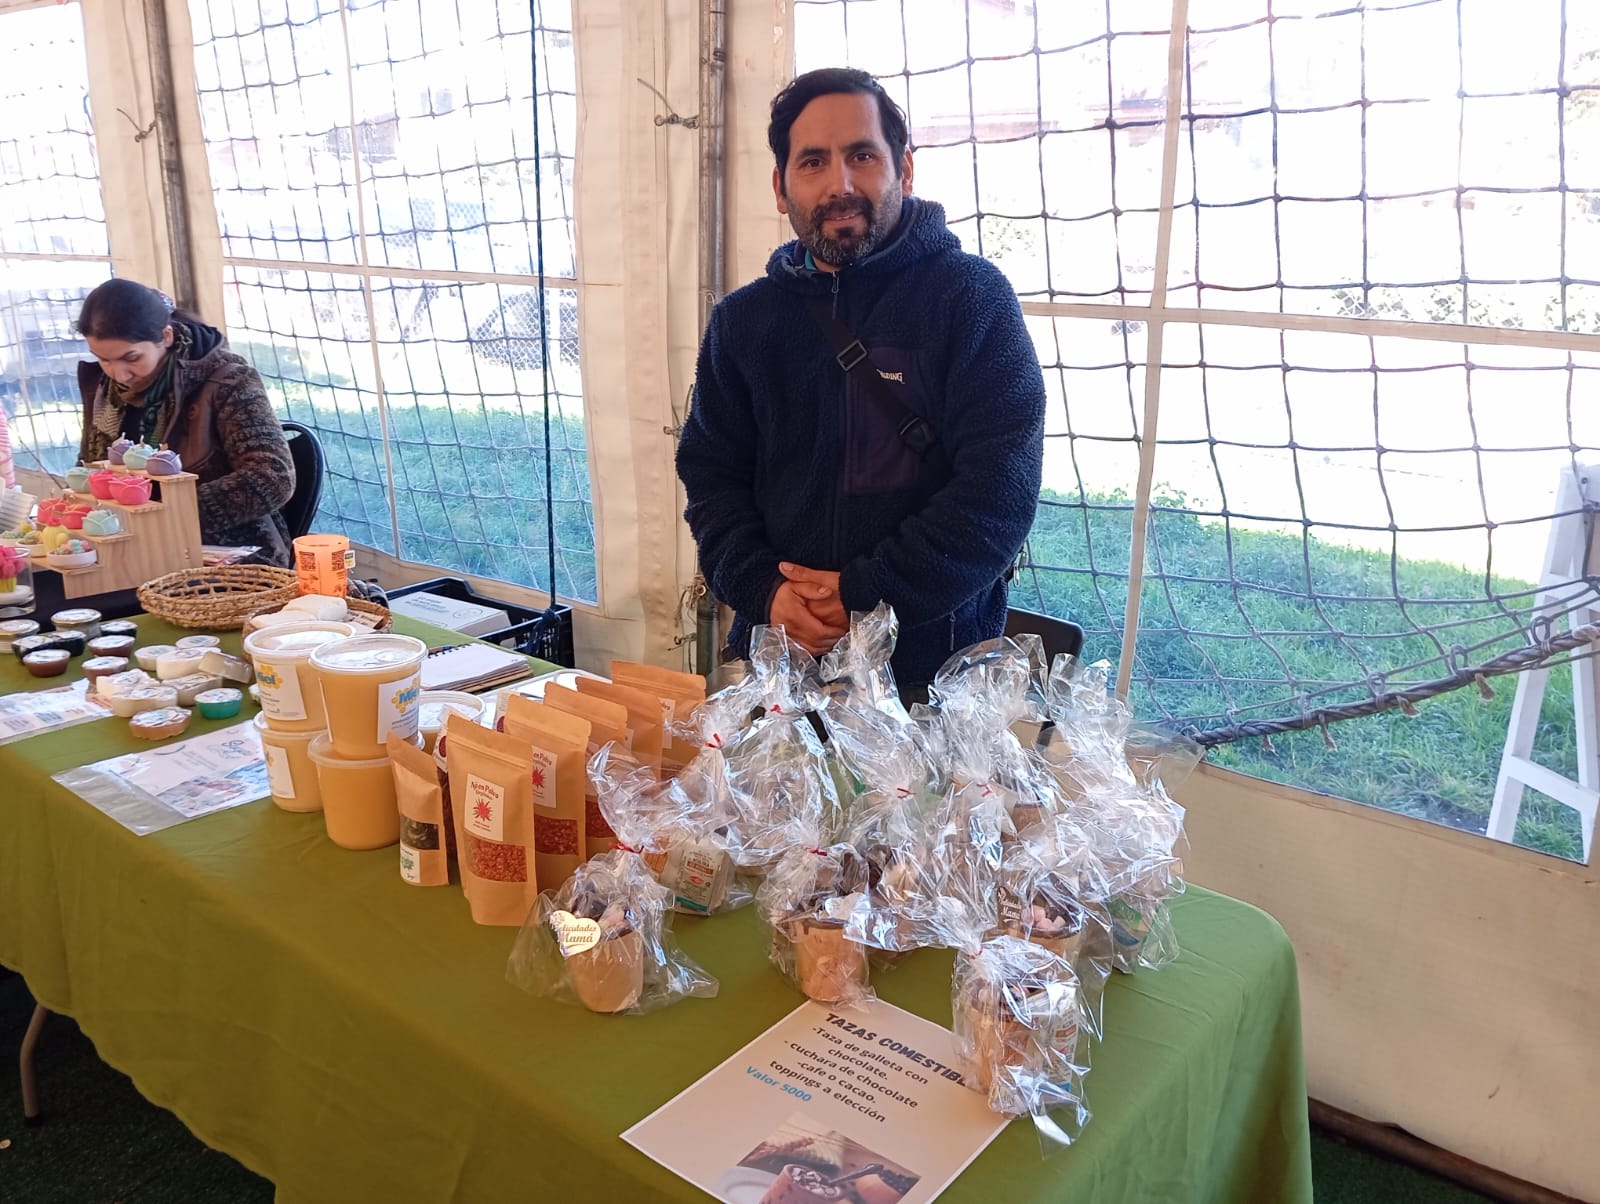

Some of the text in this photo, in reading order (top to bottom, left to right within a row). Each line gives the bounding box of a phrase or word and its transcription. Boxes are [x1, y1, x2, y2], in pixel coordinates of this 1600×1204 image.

[825, 1013, 966, 1086] TAZAS COMESTIBL
[828, 1048, 888, 1080] chocolate.
[844, 1042, 860, 1052] de
[859, 1047, 903, 1072] galleta
[904, 1069, 929, 1085] con
[746, 1065, 812, 1102] Valor 5000
[769, 1060, 886, 1122] toppings a elección
[789, 1041, 837, 1068] cuchara
[839, 1064, 855, 1076] de
[856, 1073, 918, 1108] chocolate
[838, 1079, 876, 1103] cacao.
